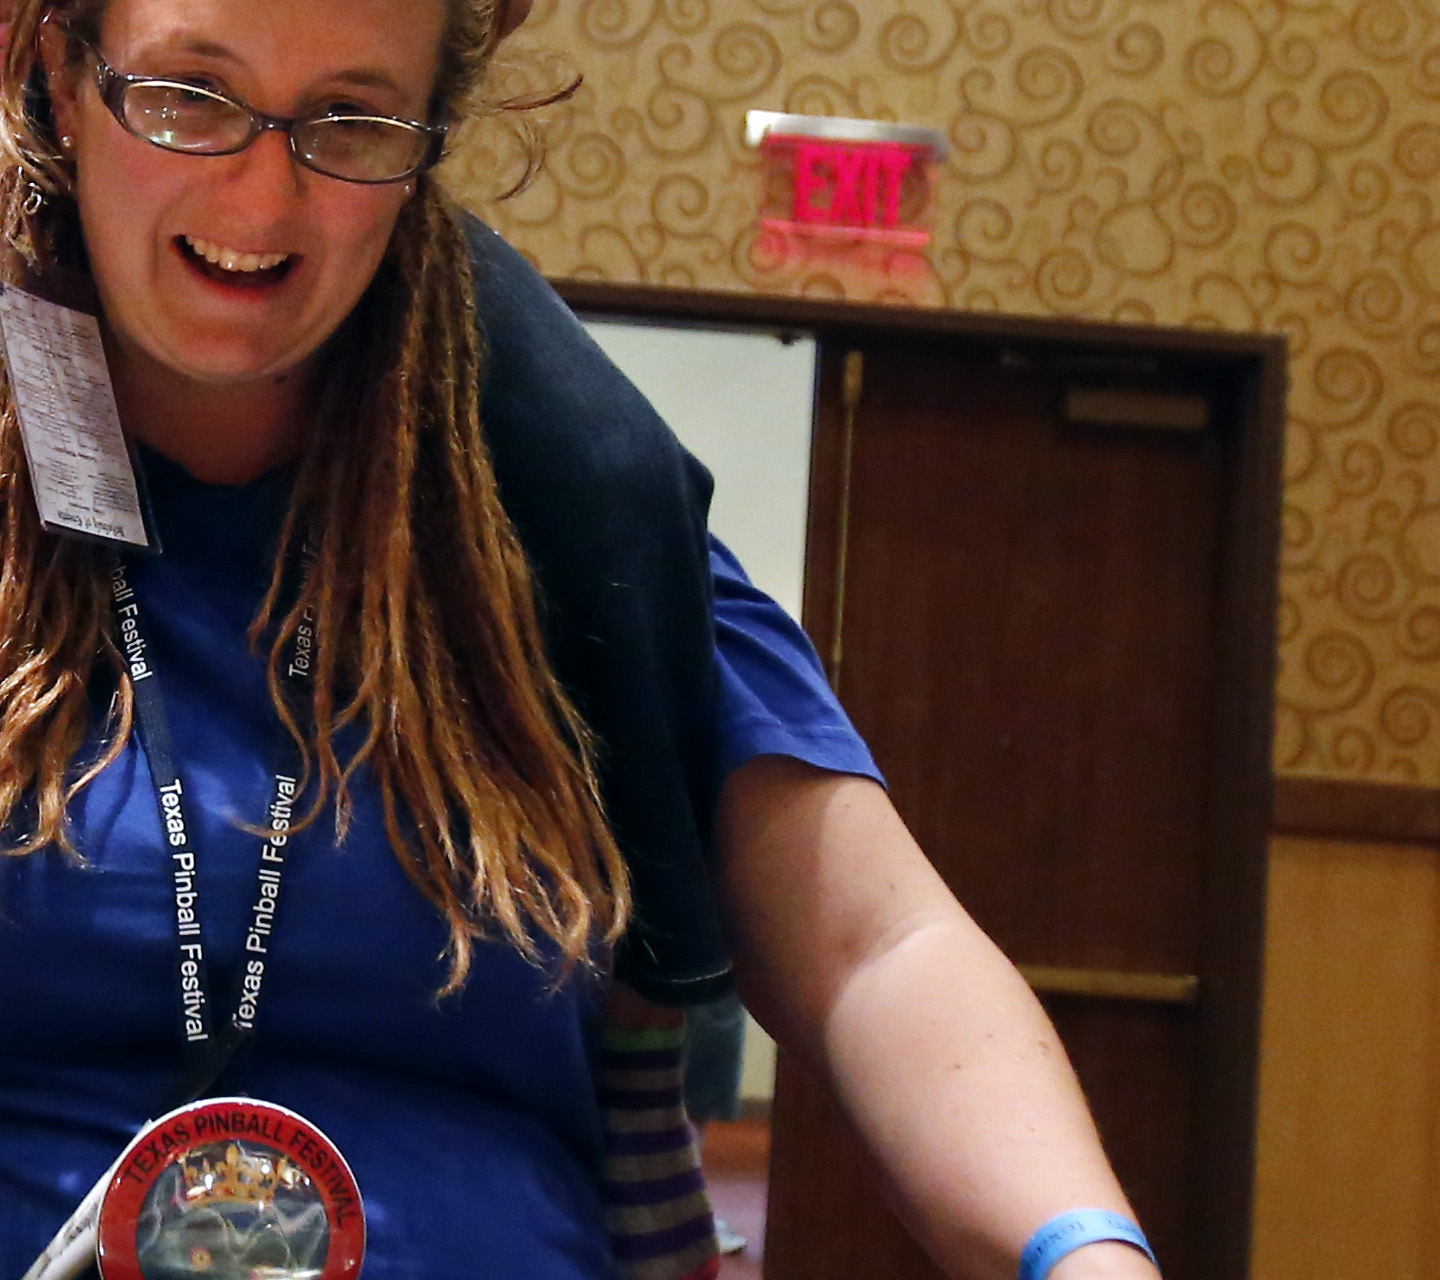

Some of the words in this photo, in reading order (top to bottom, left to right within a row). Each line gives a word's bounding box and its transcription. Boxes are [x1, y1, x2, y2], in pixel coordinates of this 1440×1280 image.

[795, 143, 912, 229] EXIT
[118, 603, 153, 681] Festival
[288, 624, 313, 677] Texas
[159, 778, 187, 847] Texas
[263, 774, 297, 862] Festival
[172, 852, 201, 937] Pinball
[245, 869, 281, 953] Pinball
[180, 943, 209, 1042] Festival
[233, 959, 264, 1030] Texas
[123, 1121, 191, 1184] TEXAS
[193, 1111, 283, 1140] PINBALL
[289, 1129, 357, 1228] FESTIVAL
